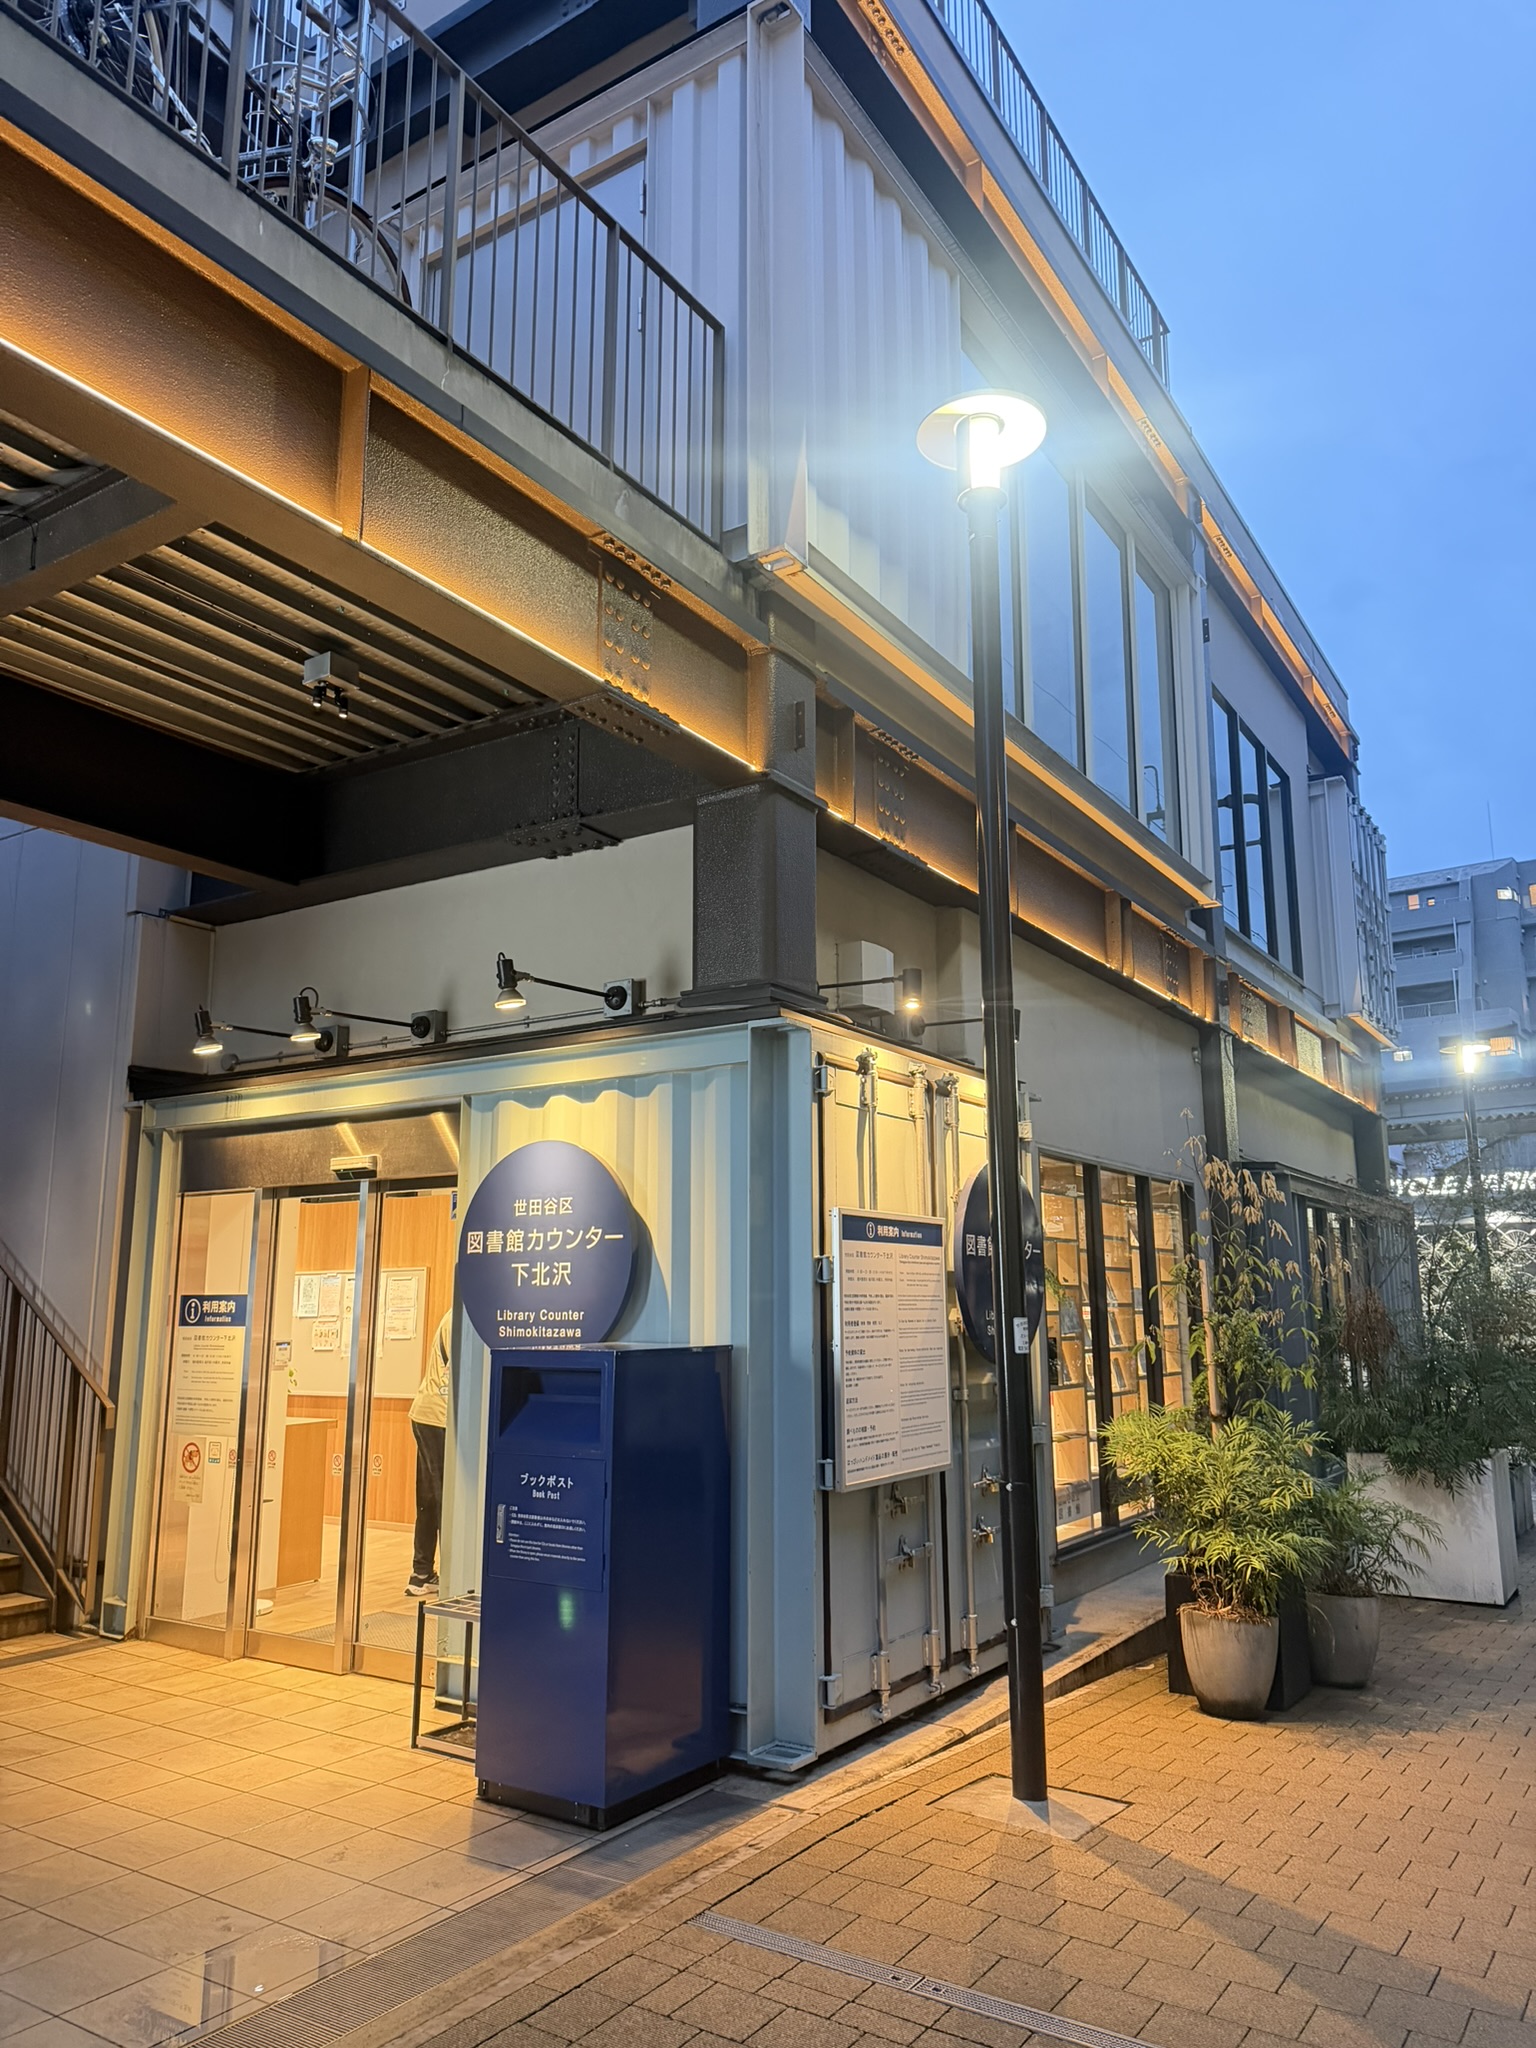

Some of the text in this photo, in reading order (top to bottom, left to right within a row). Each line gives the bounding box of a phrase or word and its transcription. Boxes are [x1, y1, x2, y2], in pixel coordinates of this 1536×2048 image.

[514, 1197, 573, 1216] 世田谷区
[467, 1226, 623, 1254] 図書館カウンター
[511, 1262, 571, 1287] 下北沢
[202, 1300, 236, 1313] 利用案内
[204, 1315, 232, 1323] Information
[497, 1309, 584, 1323] Library Counter
[499, 1326, 581, 1338] Shimokitazawa
[520, 1472, 574, 1489] ブックポスト
[532, 1489, 560, 1500] Book Post
